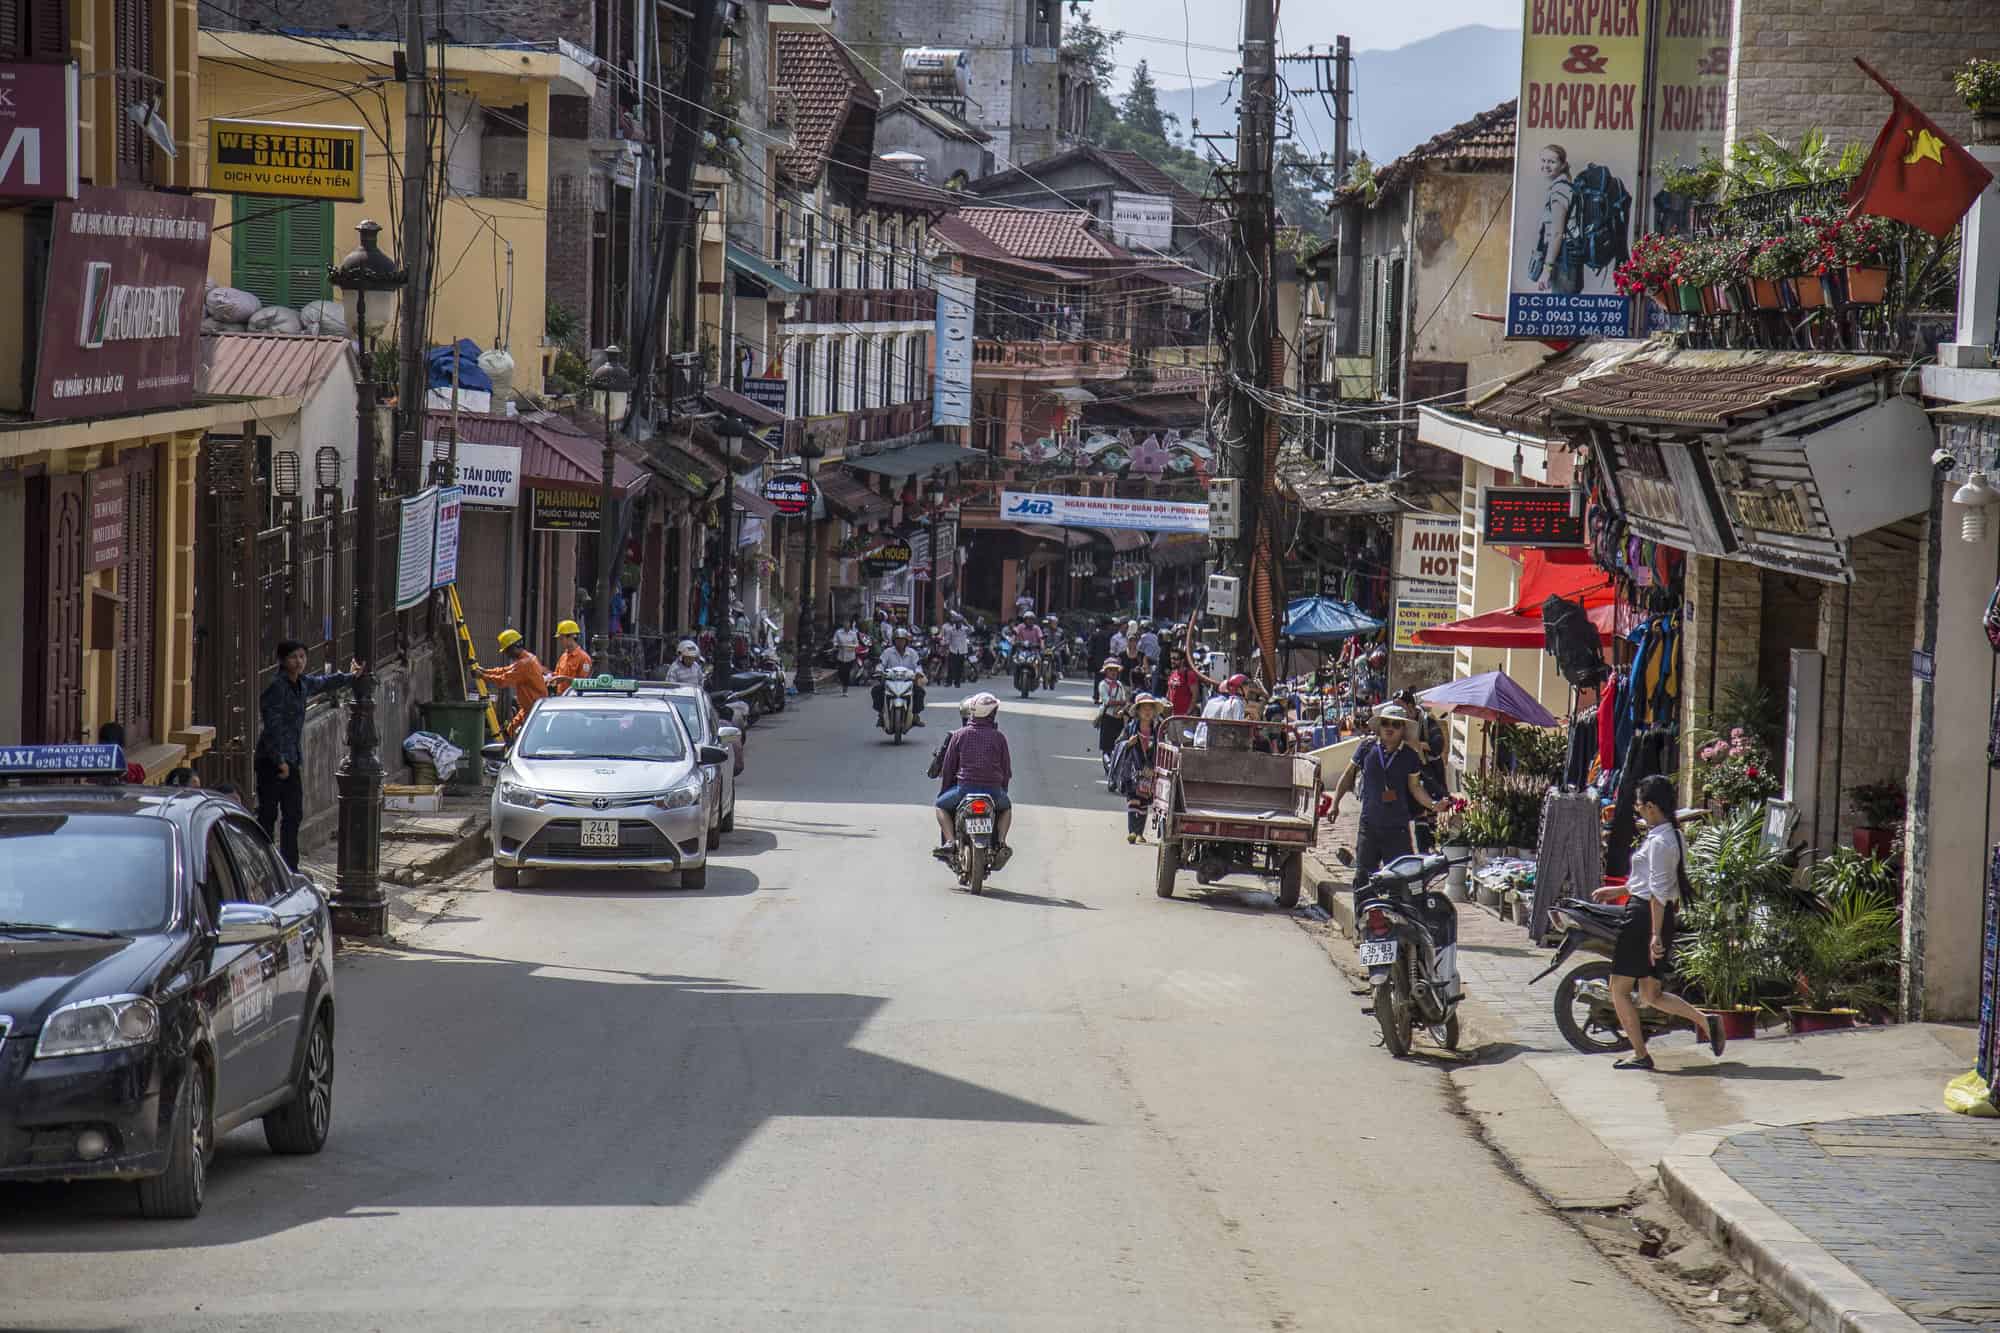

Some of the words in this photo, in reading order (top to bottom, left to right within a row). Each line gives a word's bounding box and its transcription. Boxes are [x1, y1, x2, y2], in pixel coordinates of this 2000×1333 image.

[1532, 0, 1639, 36] BACKPACK
[1562, 44, 1608, 74] &
[1527, 82, 1636, 130] BACKPACK
[220, 133, 329, 153] WESTERN
[254, 151, 329, 168] UNION
[224, 171, 251, 183] DỊCH
[255, 173, 271, 185] VỤ
[1546, 297, 1567, 307] 014
[1570, 297, 1595, 308] Cau
[1598, 298, 1623, 311] May
[103, 285, 185, 341] AGRIBANK
[1546, 311, 1574, 322] 0943
[1578, 311, 1598, 323] 136
[1601, 312, 1622, 323] 789
[1542, 324, 1576, 336] 01237
[1579, 325, 1600, 336] 646
[1603, 325, 1625, 337] 886
[463, 465, 482, 482] TÂN
[485, 469, 512, 486] DƯỢC
[65, 755, 79, 769] 62
[81, 755, 95, 769] 62
[97, 754, 111, 768] 62
[591, 821, 609, 833] 24A
